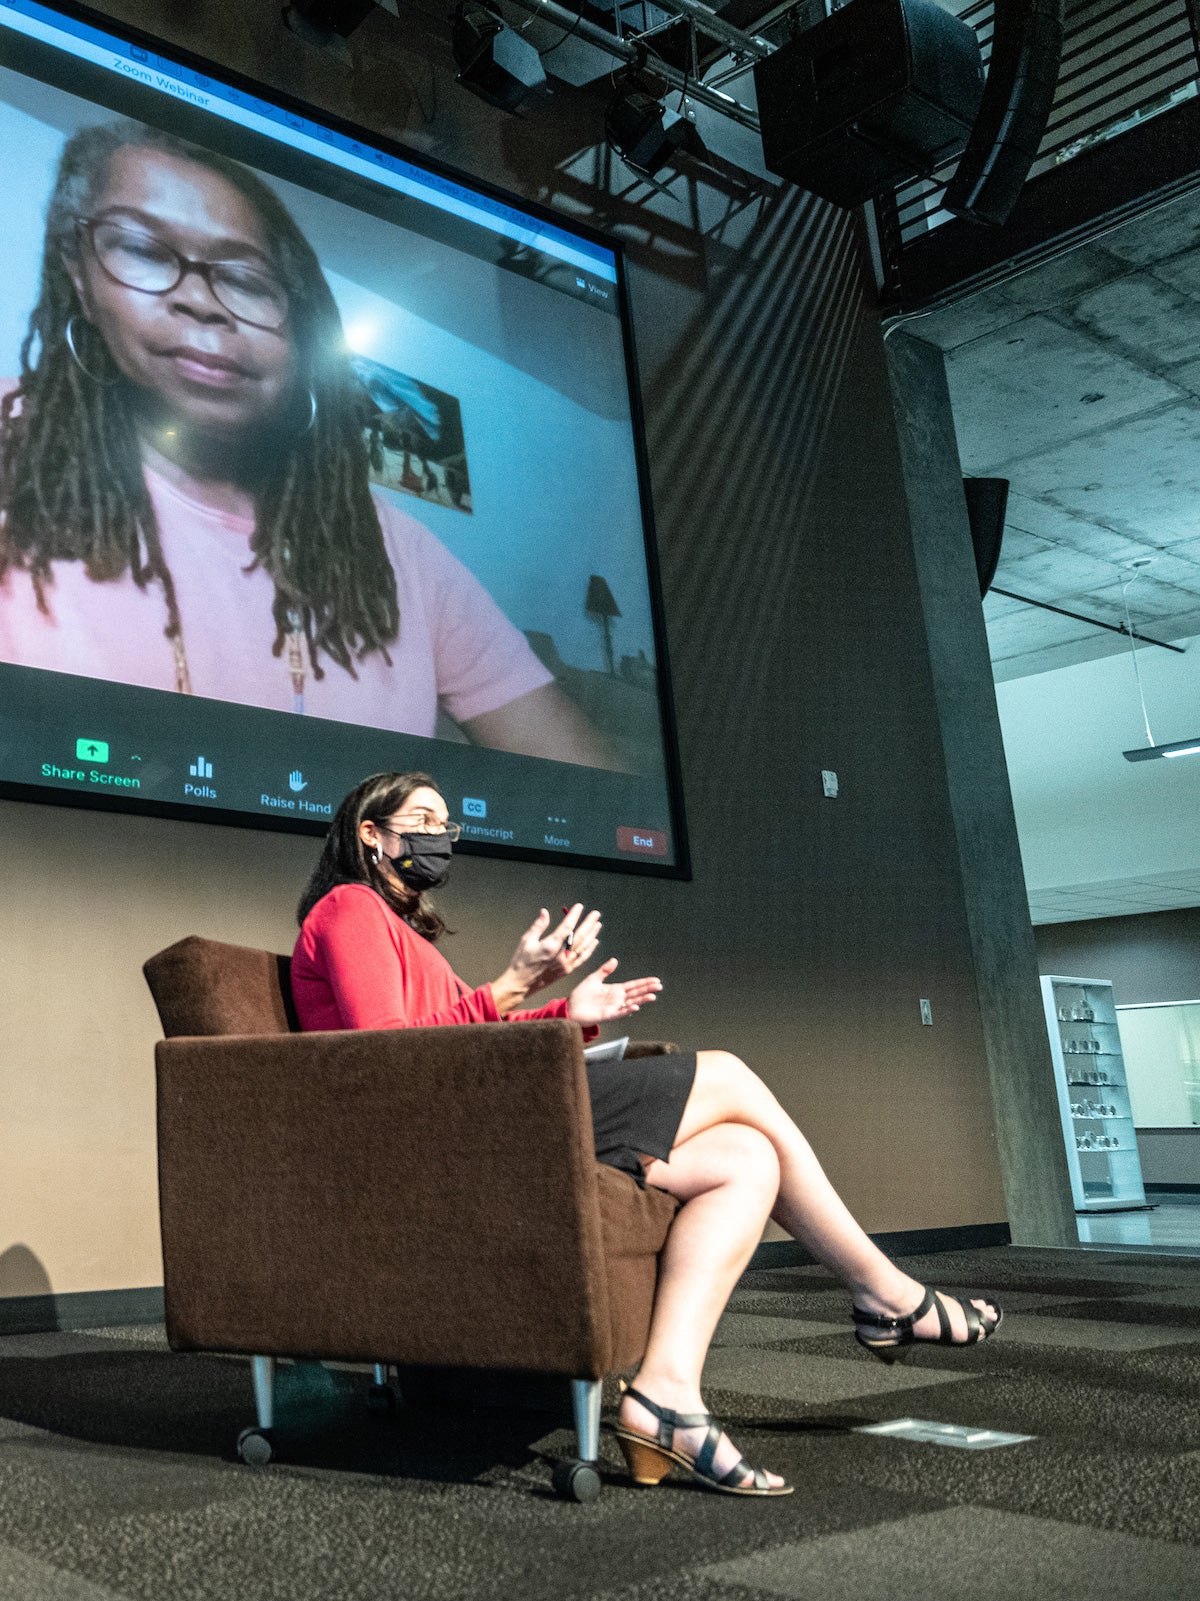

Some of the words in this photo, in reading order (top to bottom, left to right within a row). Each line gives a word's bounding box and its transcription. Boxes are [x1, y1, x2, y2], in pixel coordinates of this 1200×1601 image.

[113, 58, 152, 82] Zoom
[156, 75, 209, 106] Webinar
[41, 763, 85, 783] Share
[89, 770, 141, 789] Screen
[184, 783, 217, 799] Polls
[261, 794, 295, 810] Raise
[299, 800, 332, 815] Hand
[467, 803, 482, 813] CC
[461, 822, 514, 840] Transcript
[544, 835, 570, 847] More
[633, 836, 653, 848] End
